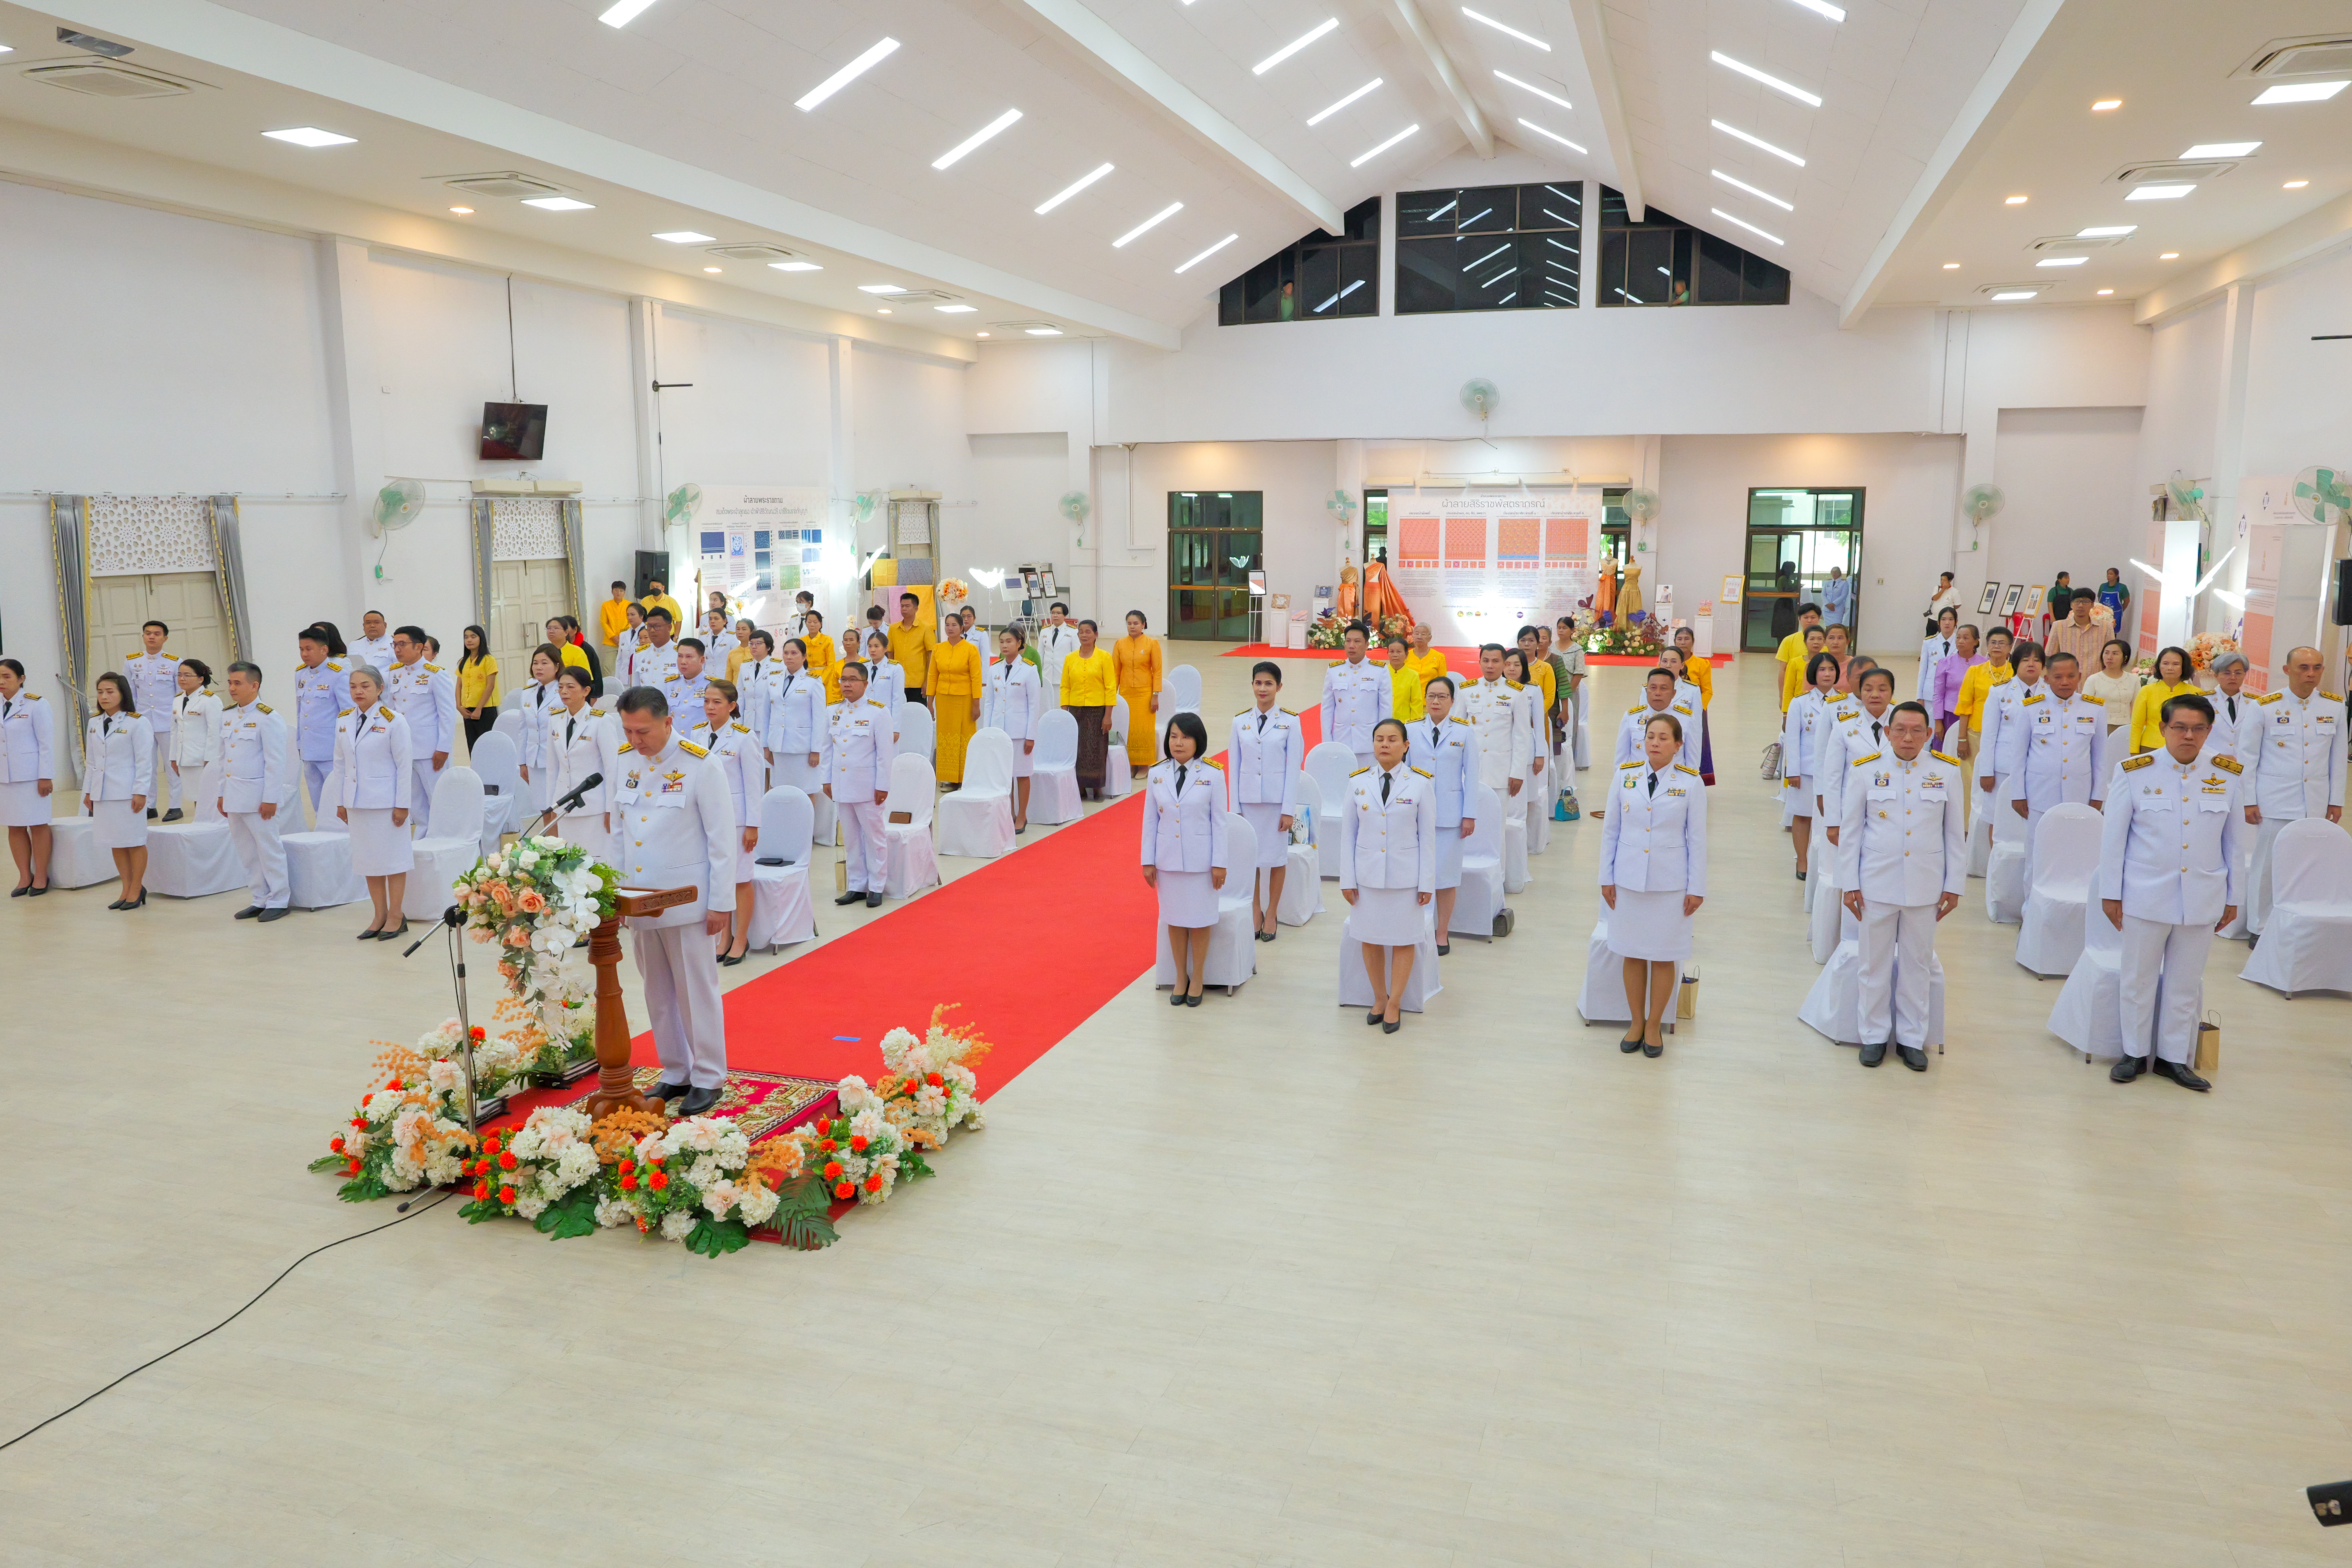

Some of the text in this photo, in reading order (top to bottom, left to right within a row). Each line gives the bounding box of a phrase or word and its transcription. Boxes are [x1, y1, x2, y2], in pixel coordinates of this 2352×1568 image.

[744, 495, 783, 503] ผ้าลายพระราชทาน
[1442, 498, 1546, 508] ผ้าลายสิริราชพัสตราภรณ์
